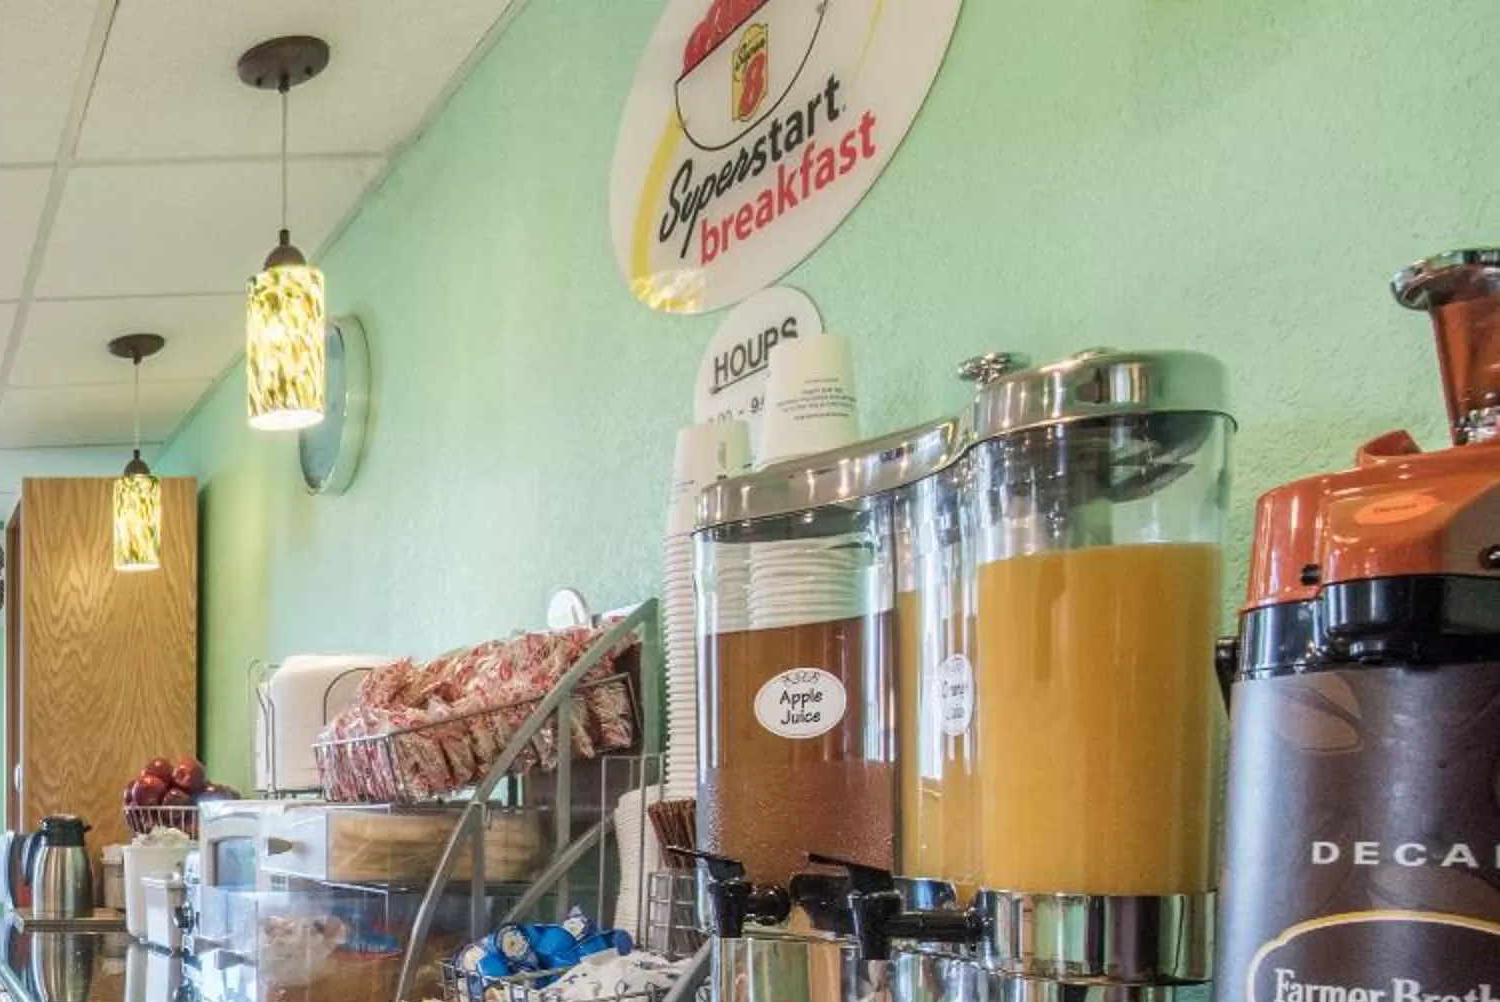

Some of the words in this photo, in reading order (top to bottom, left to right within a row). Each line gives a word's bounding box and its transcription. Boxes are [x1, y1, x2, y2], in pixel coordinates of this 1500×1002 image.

[659, 73, 841, 258] Superstart
[700, 109, 877, 267] breakfast
[780, 688, 824, 710] Apple
[780, 709, 821, 725] Juice
[1311, 842, 1500, 868] DECA
